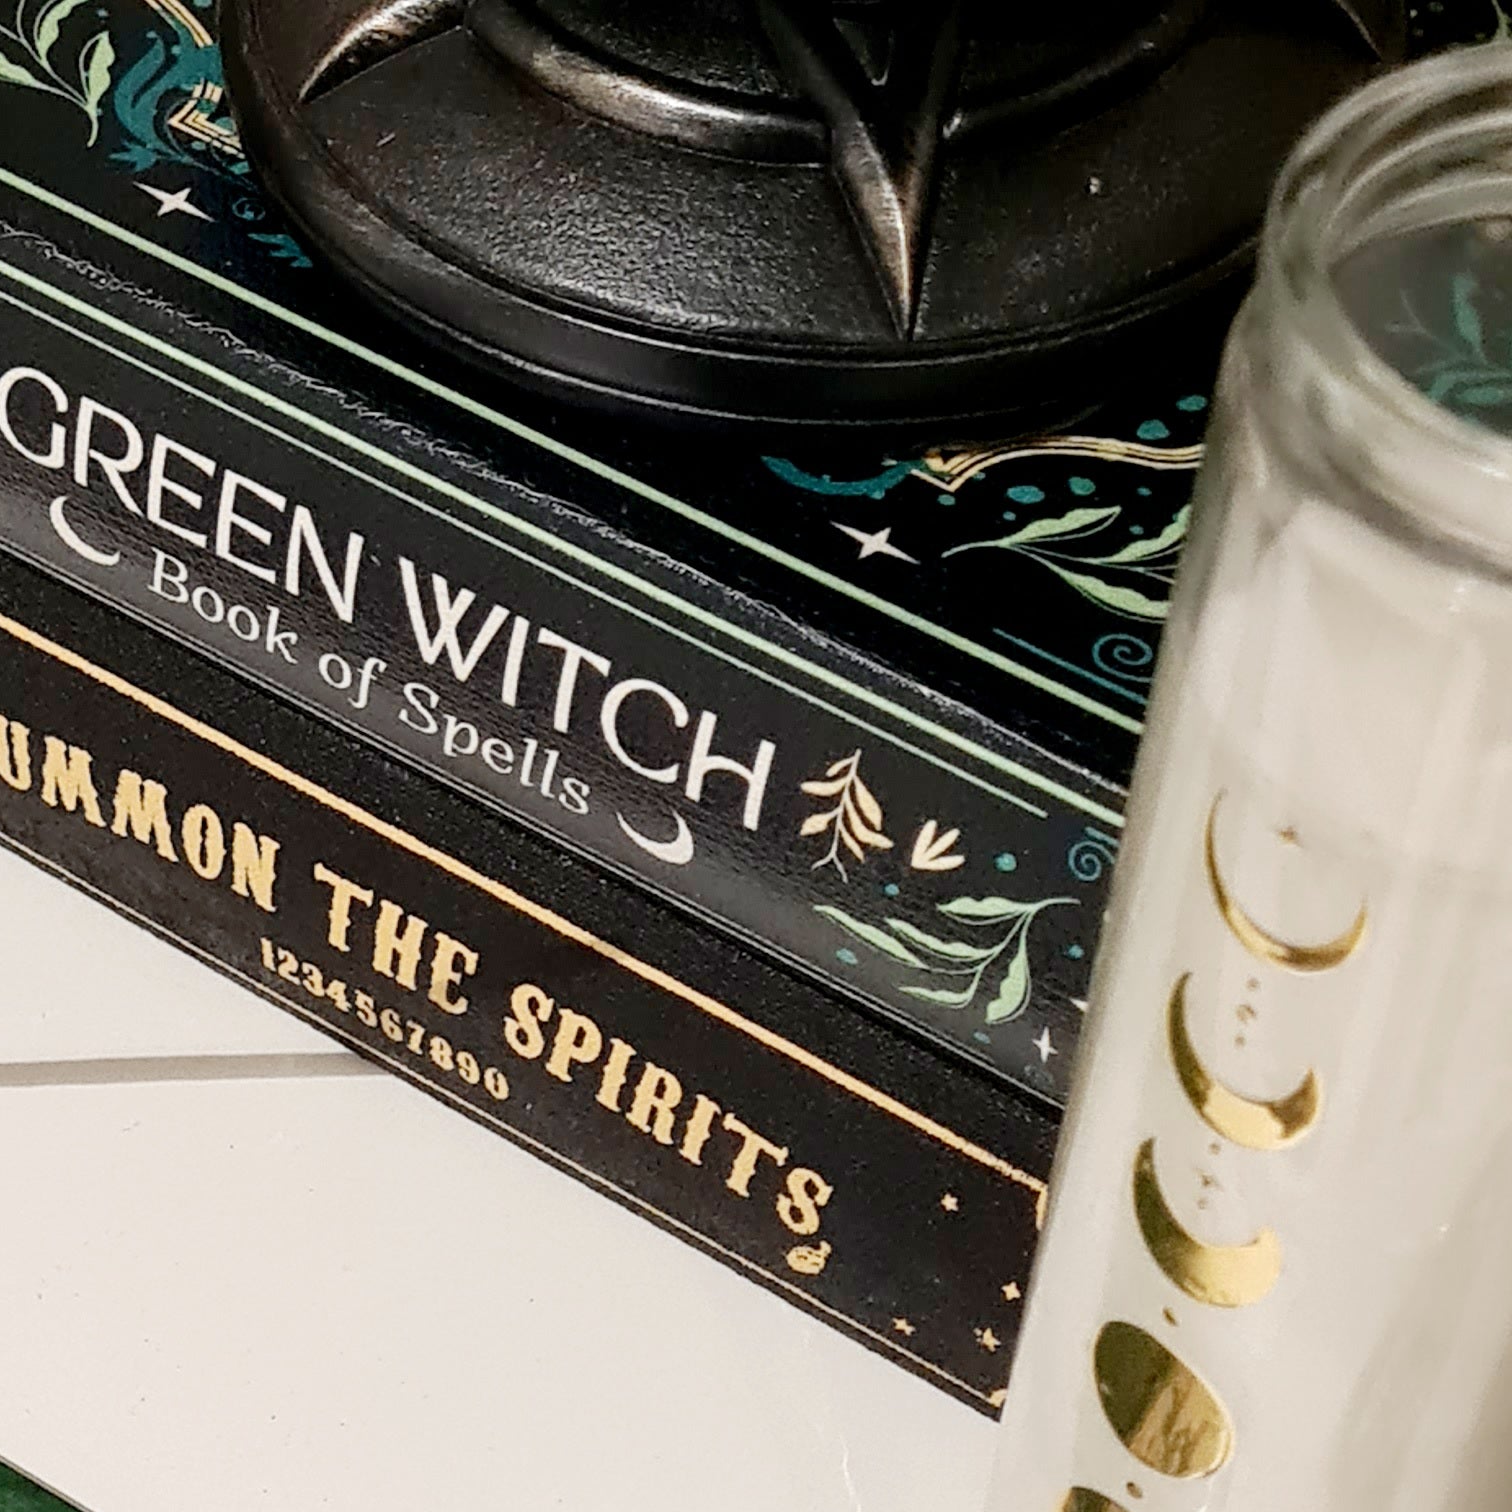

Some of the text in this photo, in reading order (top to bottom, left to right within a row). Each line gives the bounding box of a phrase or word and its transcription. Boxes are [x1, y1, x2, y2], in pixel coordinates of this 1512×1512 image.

[148, 548, 591, 816] Book of Spells
[399, 554, 778, 831] WITCH
[260, 938, 510, 1100] 1234567890
[314, 863, 480, 1015] THE
[504, 985, 834, 1235] SPIRITS
